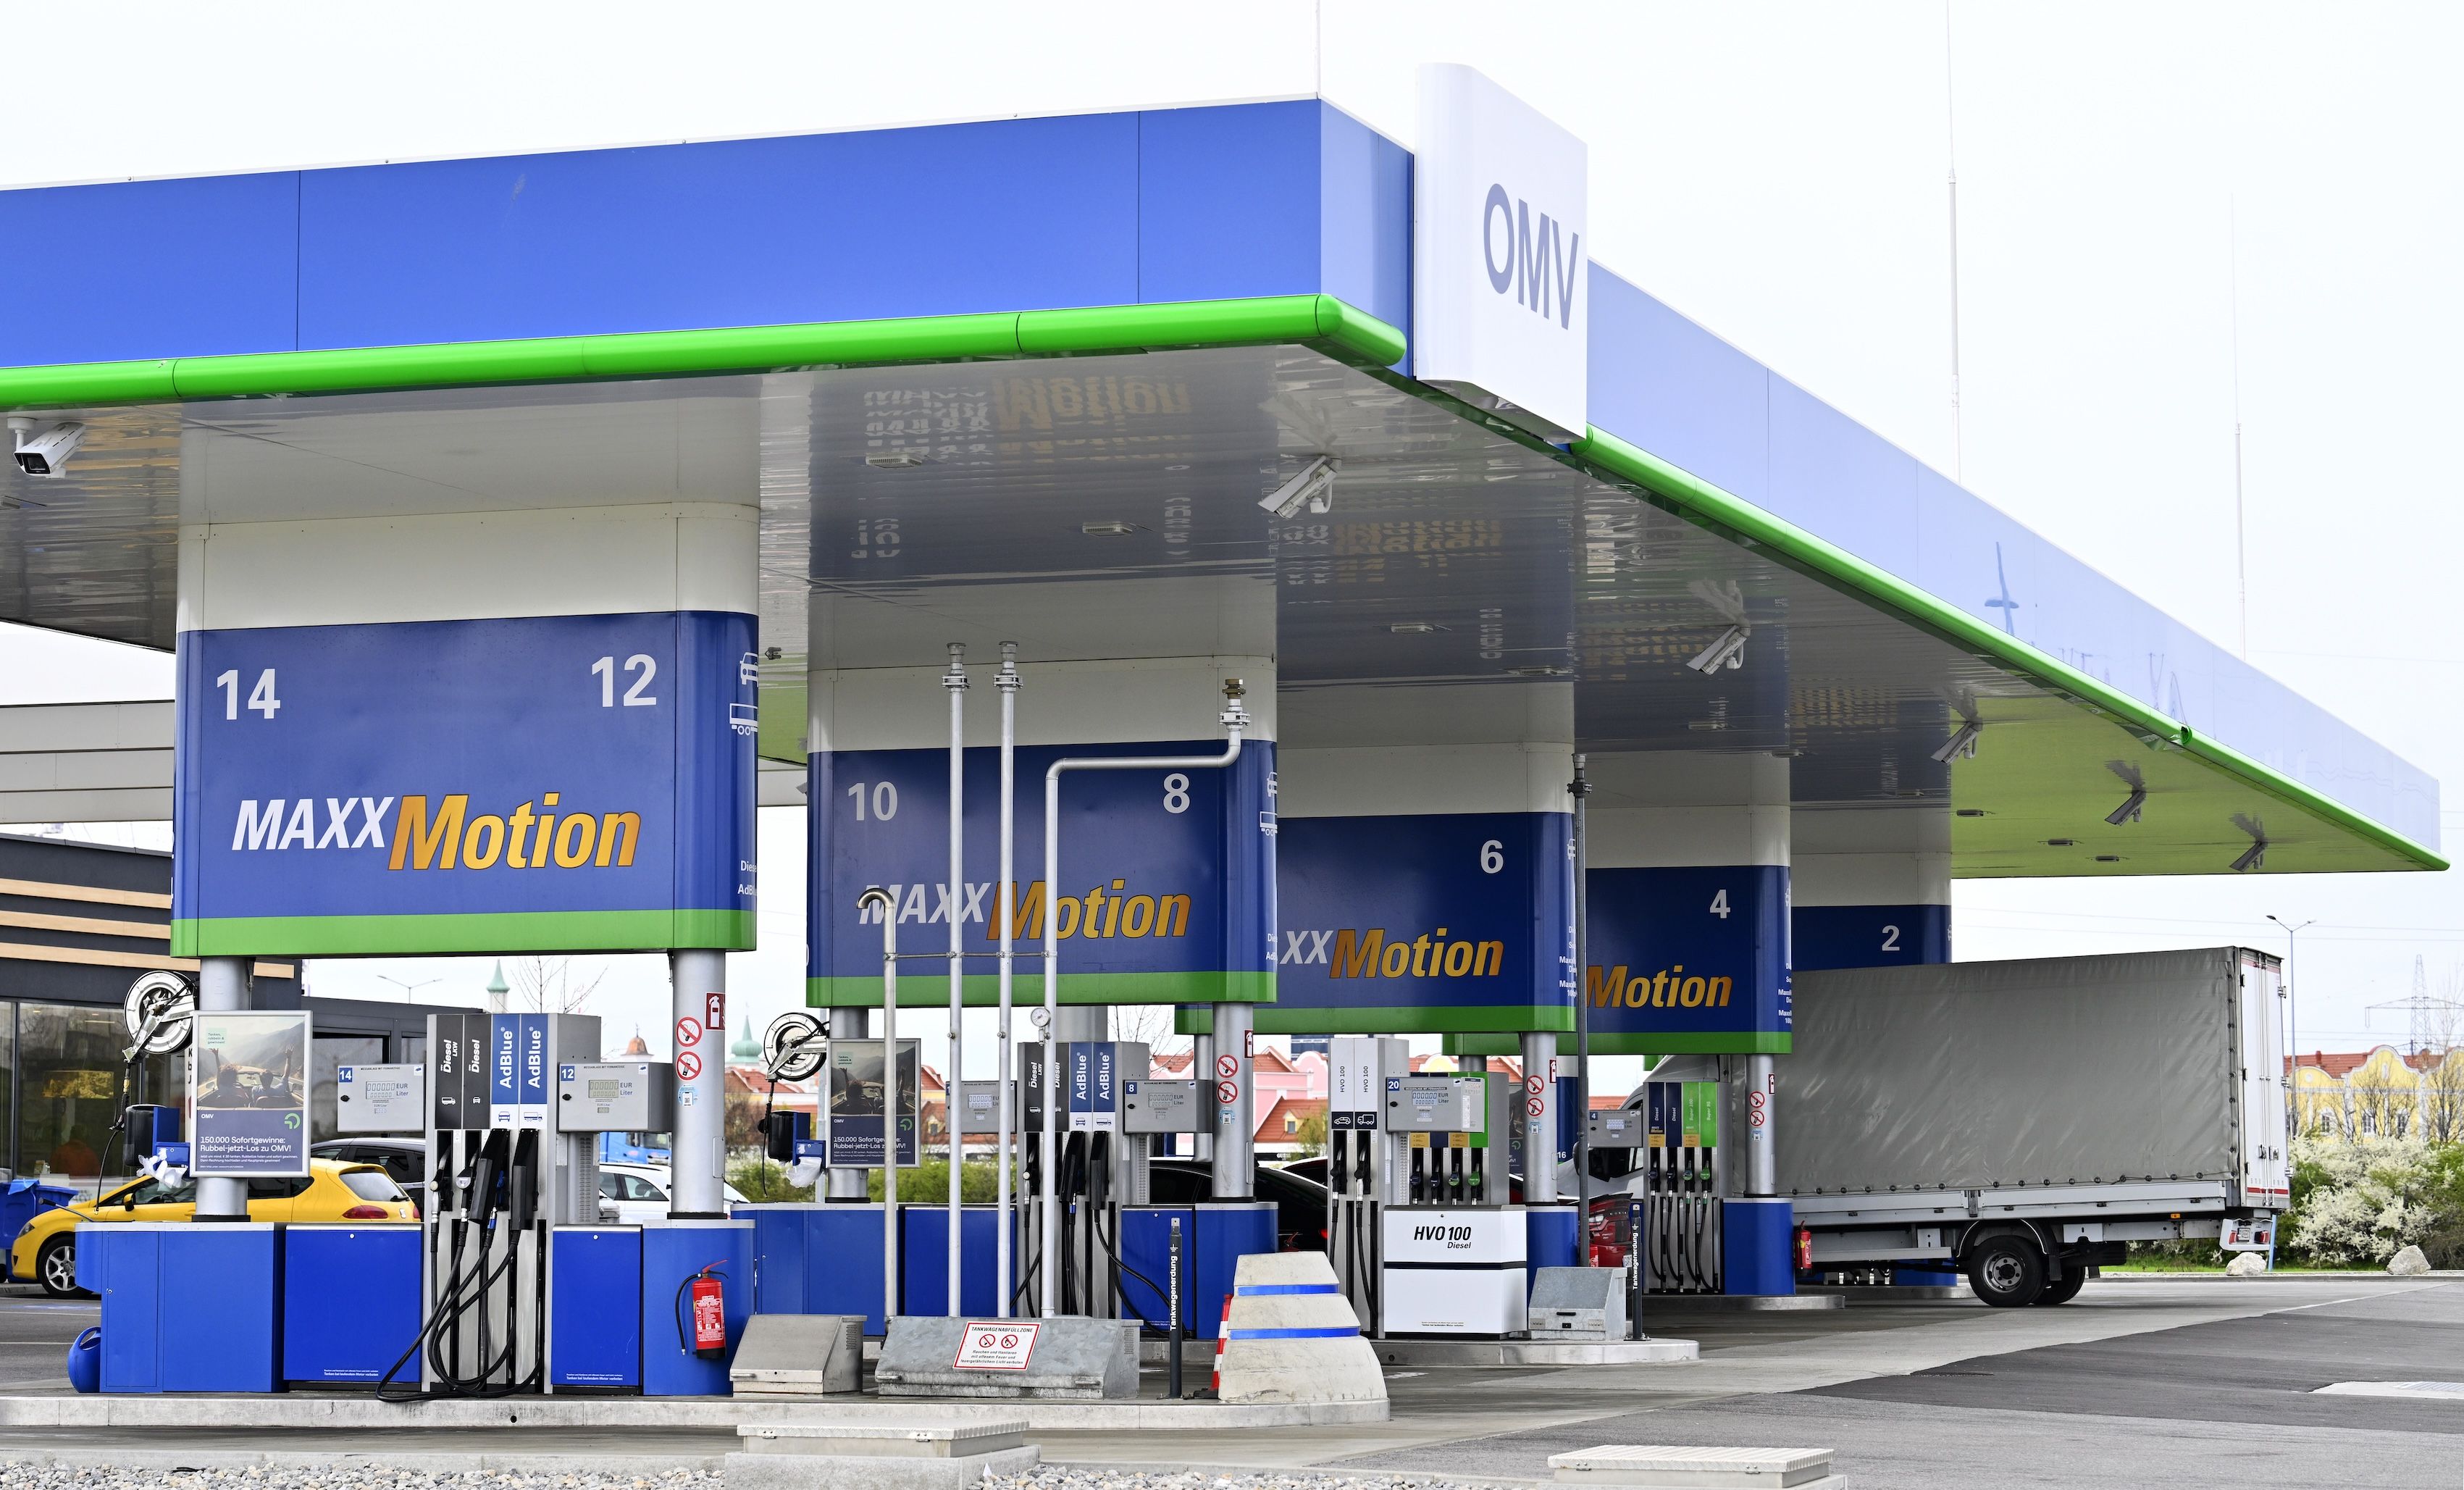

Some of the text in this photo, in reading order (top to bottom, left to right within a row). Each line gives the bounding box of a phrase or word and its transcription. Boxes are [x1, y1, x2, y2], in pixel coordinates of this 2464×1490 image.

[1483, 183, 1579, 330] OMV
[216, 669, 282, 721] 14
[592, 654, 657, 708] 12
[847, 782, 898, 821] 10
[1162, 773, 1191, 814] 8
[1480, 840, 1504, 874] 6
[1709, 889, 1731, 918] 4
[1881, 925, 1901, 952] 2
[443, 1039, 452, 1073] Diesel
[471, 1039, 480, 1073] Diesel
[340, 1071, 352, 1080] 14
[561, 1068, 574, 1079] 12
[1388, 1081, 1399, 1089] 20
[232, 1136, 285, 1144] Sofortgewinne:
[1414, 1226, 1472, 1241] HVO 100
